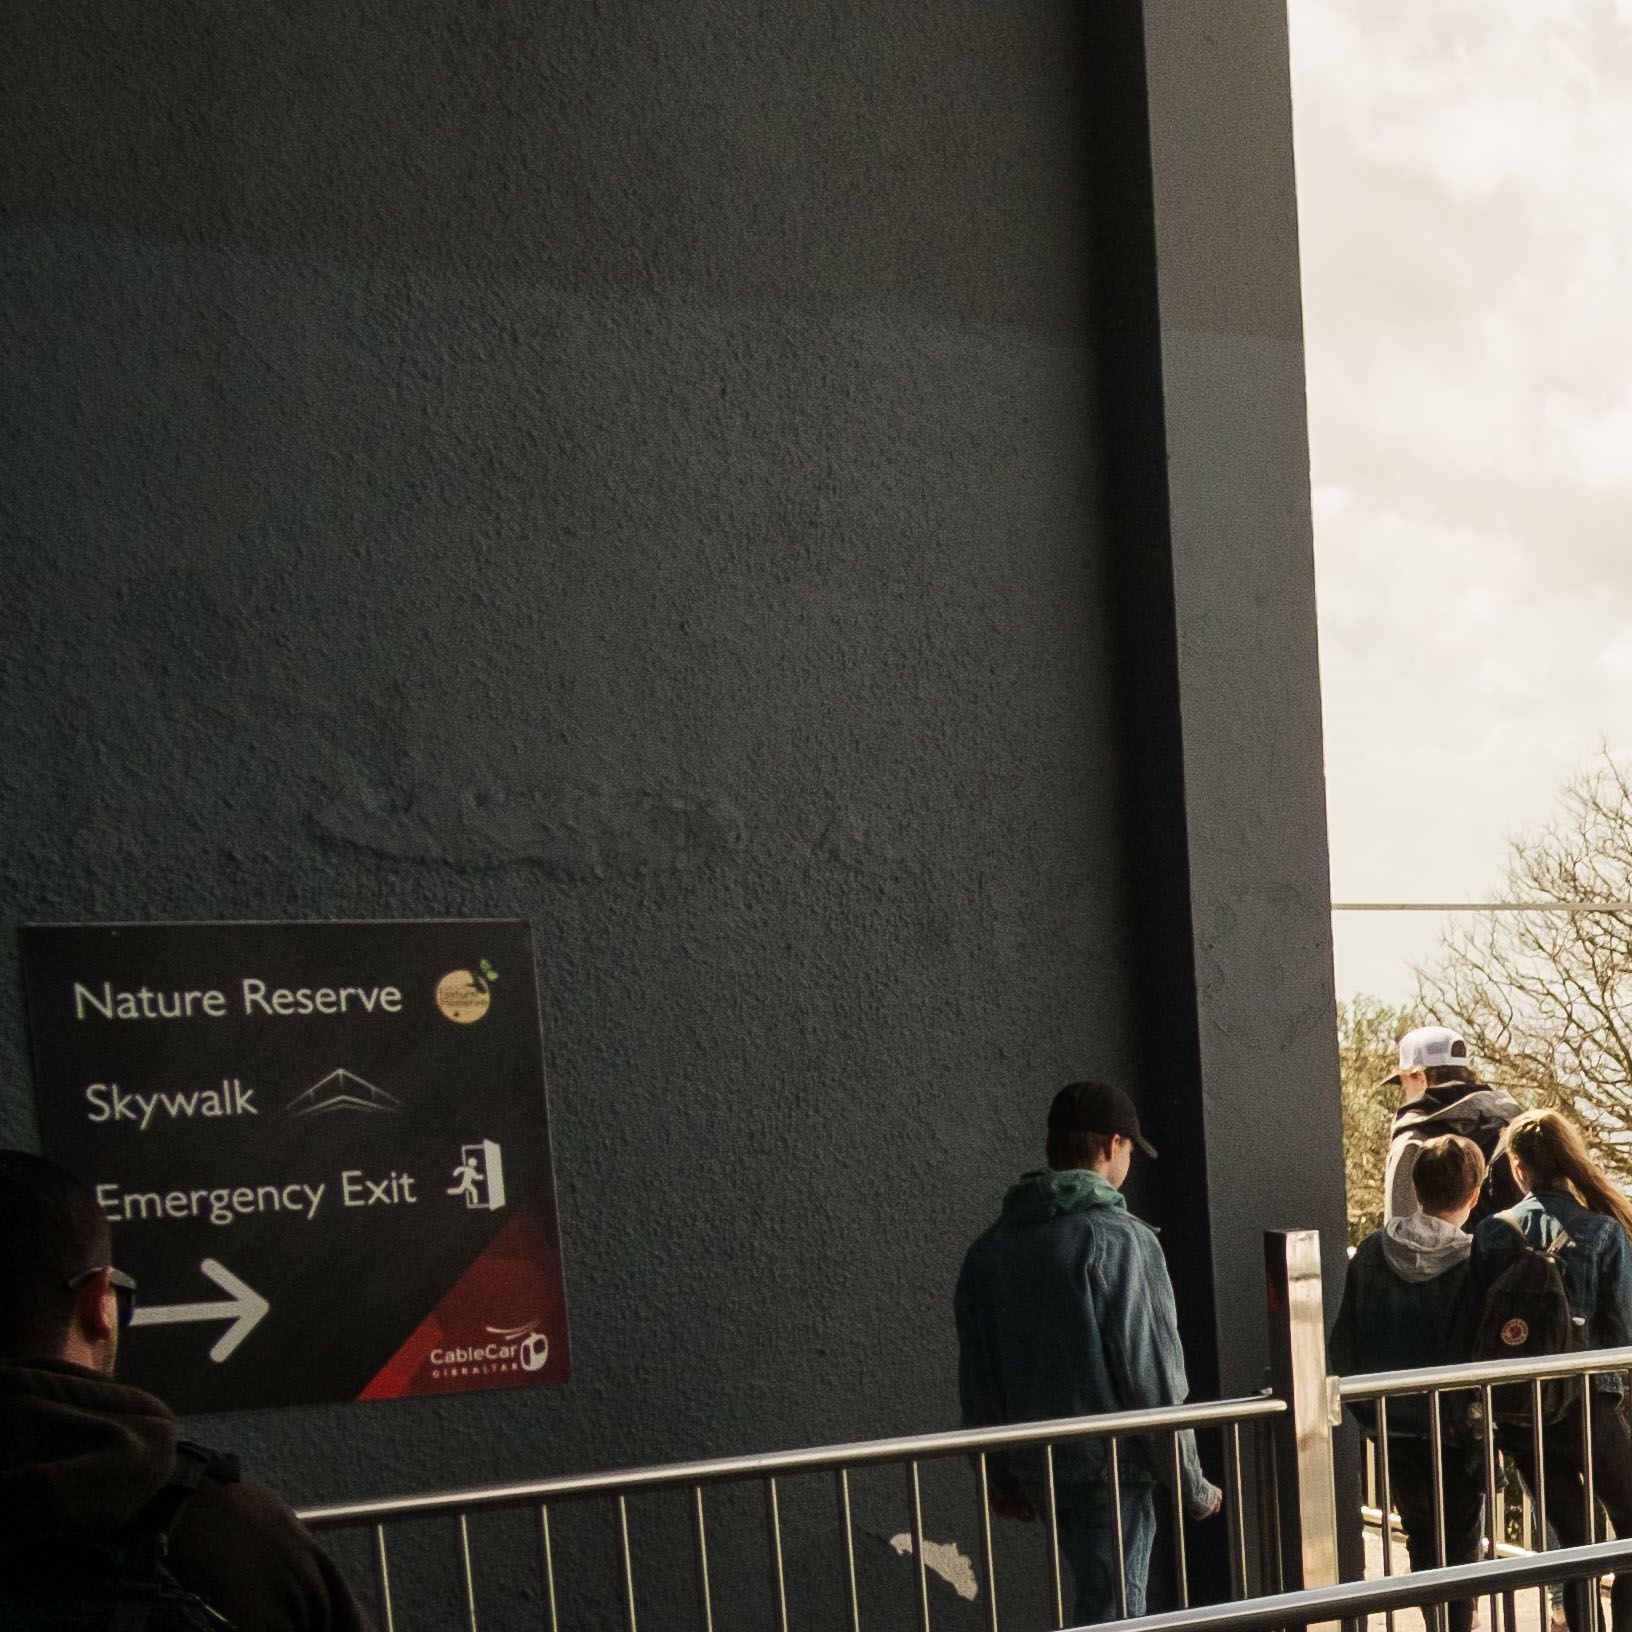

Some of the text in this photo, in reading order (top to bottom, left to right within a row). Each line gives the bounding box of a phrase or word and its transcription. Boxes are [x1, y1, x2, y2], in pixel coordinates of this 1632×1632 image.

[73, 981, 227, 1020] Nature
[242, 979, 402, 1016] Reserve
[85, 1078, 258, 1131] Skywalk
[95, 1169, 418, 1226] Emergency Exit
[430, 1344, 518, 1366] CableCar
